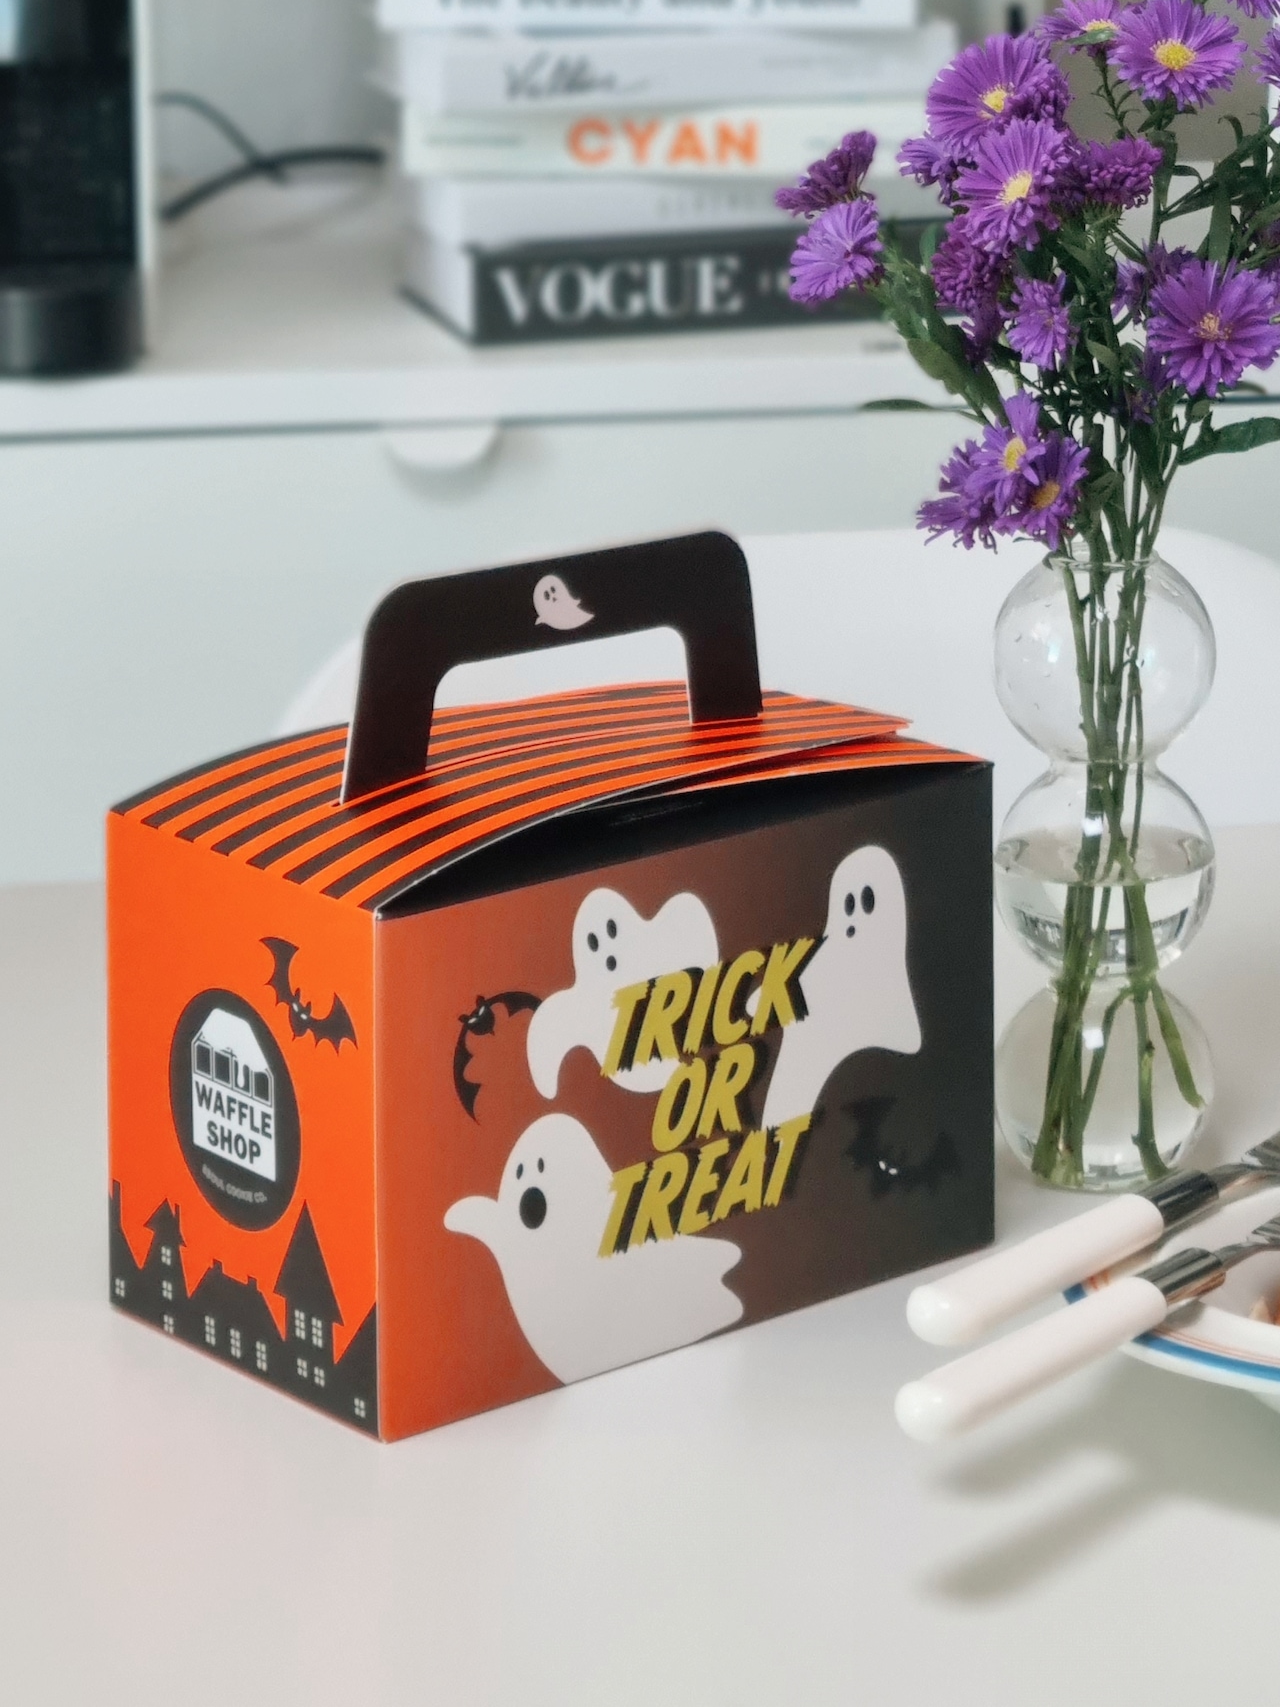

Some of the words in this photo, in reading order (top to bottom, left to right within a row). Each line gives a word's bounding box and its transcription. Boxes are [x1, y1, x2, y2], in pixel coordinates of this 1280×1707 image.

[566, 116, 759, 165] CYAN
[495, 254, 743, 325] VOGUE
[601, 934, 816, 1077] TRICK
[195, 1080, 273, 1140] WAFFLE
[651, 1042, 756, 1153] OR
[206, 1120, 262, 1165] SHOP
[597, 1112, 812, 1259] TREAT
